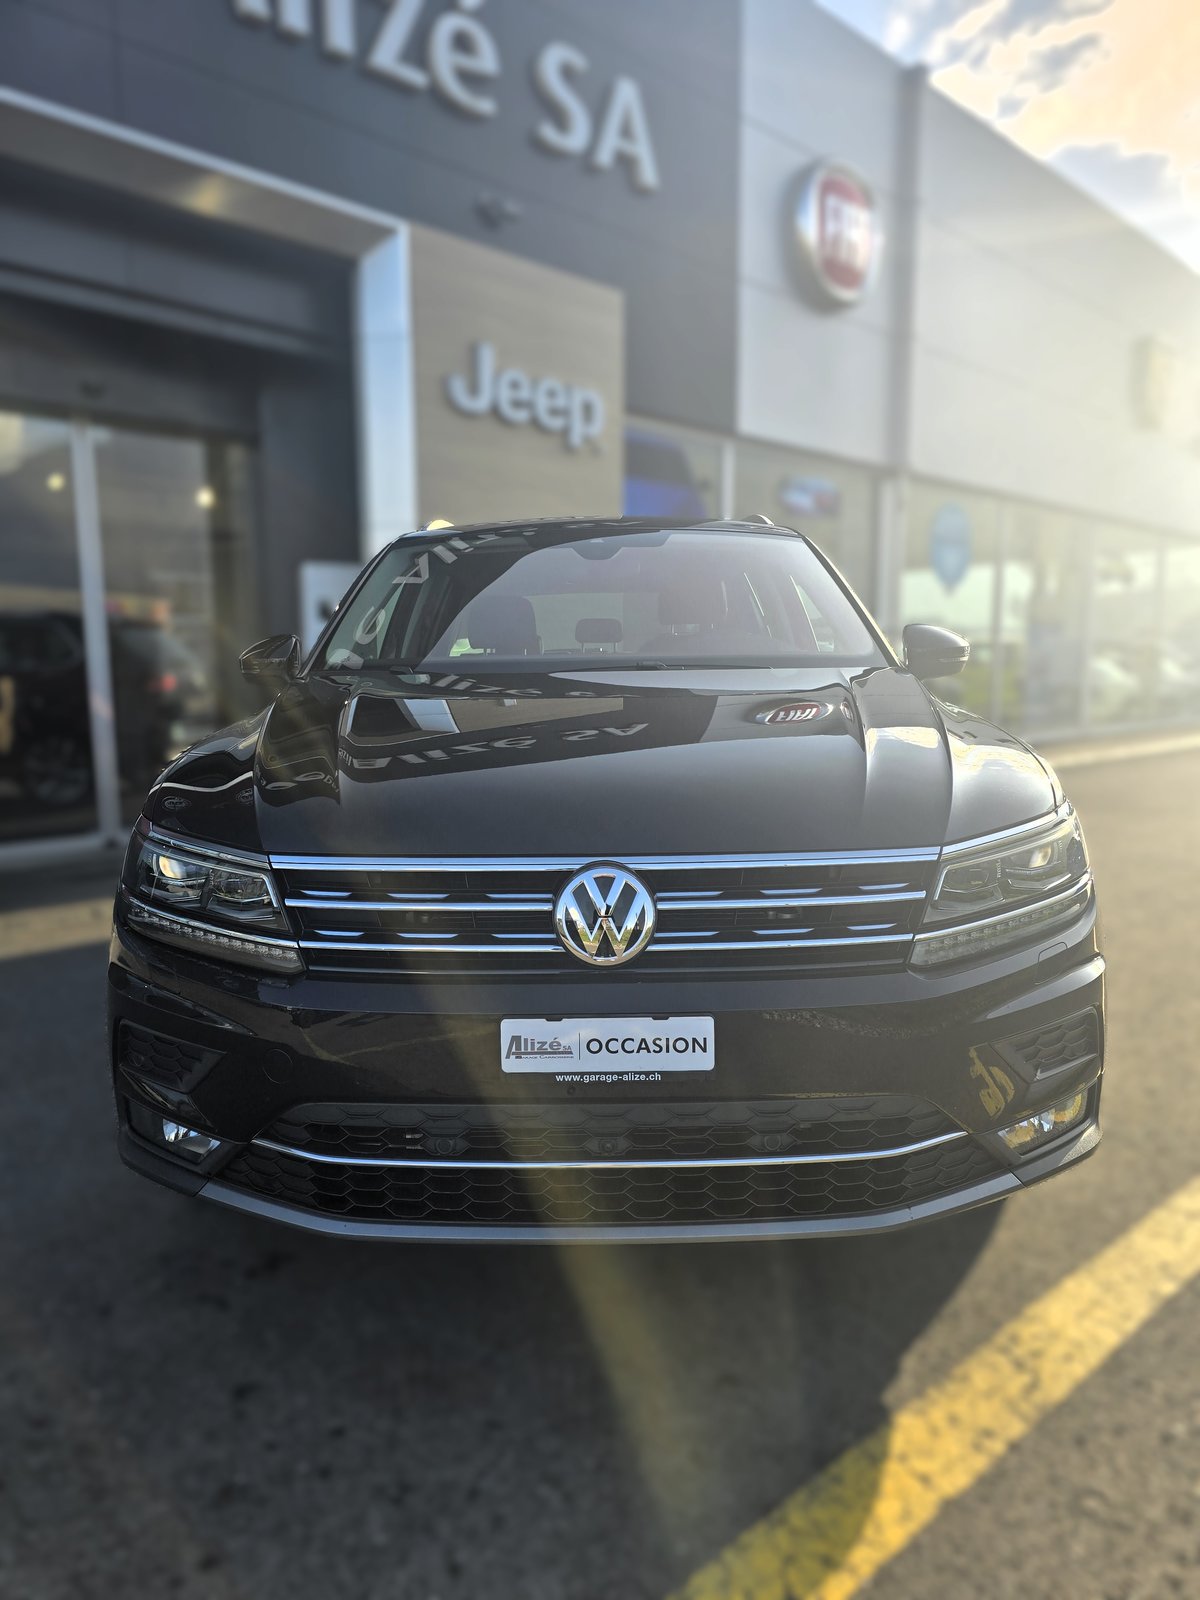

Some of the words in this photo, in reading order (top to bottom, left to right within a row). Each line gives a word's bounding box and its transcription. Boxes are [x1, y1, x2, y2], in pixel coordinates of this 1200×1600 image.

[535, 40, 661, 191] SA
[448, 342, 605, 449] Jeep
[505, 1035, 562, 1059] Alizé
[585, 1037, 708, 1054] OCCASION
[555, 1072, 662, 1082] www.garage-alize.ch
